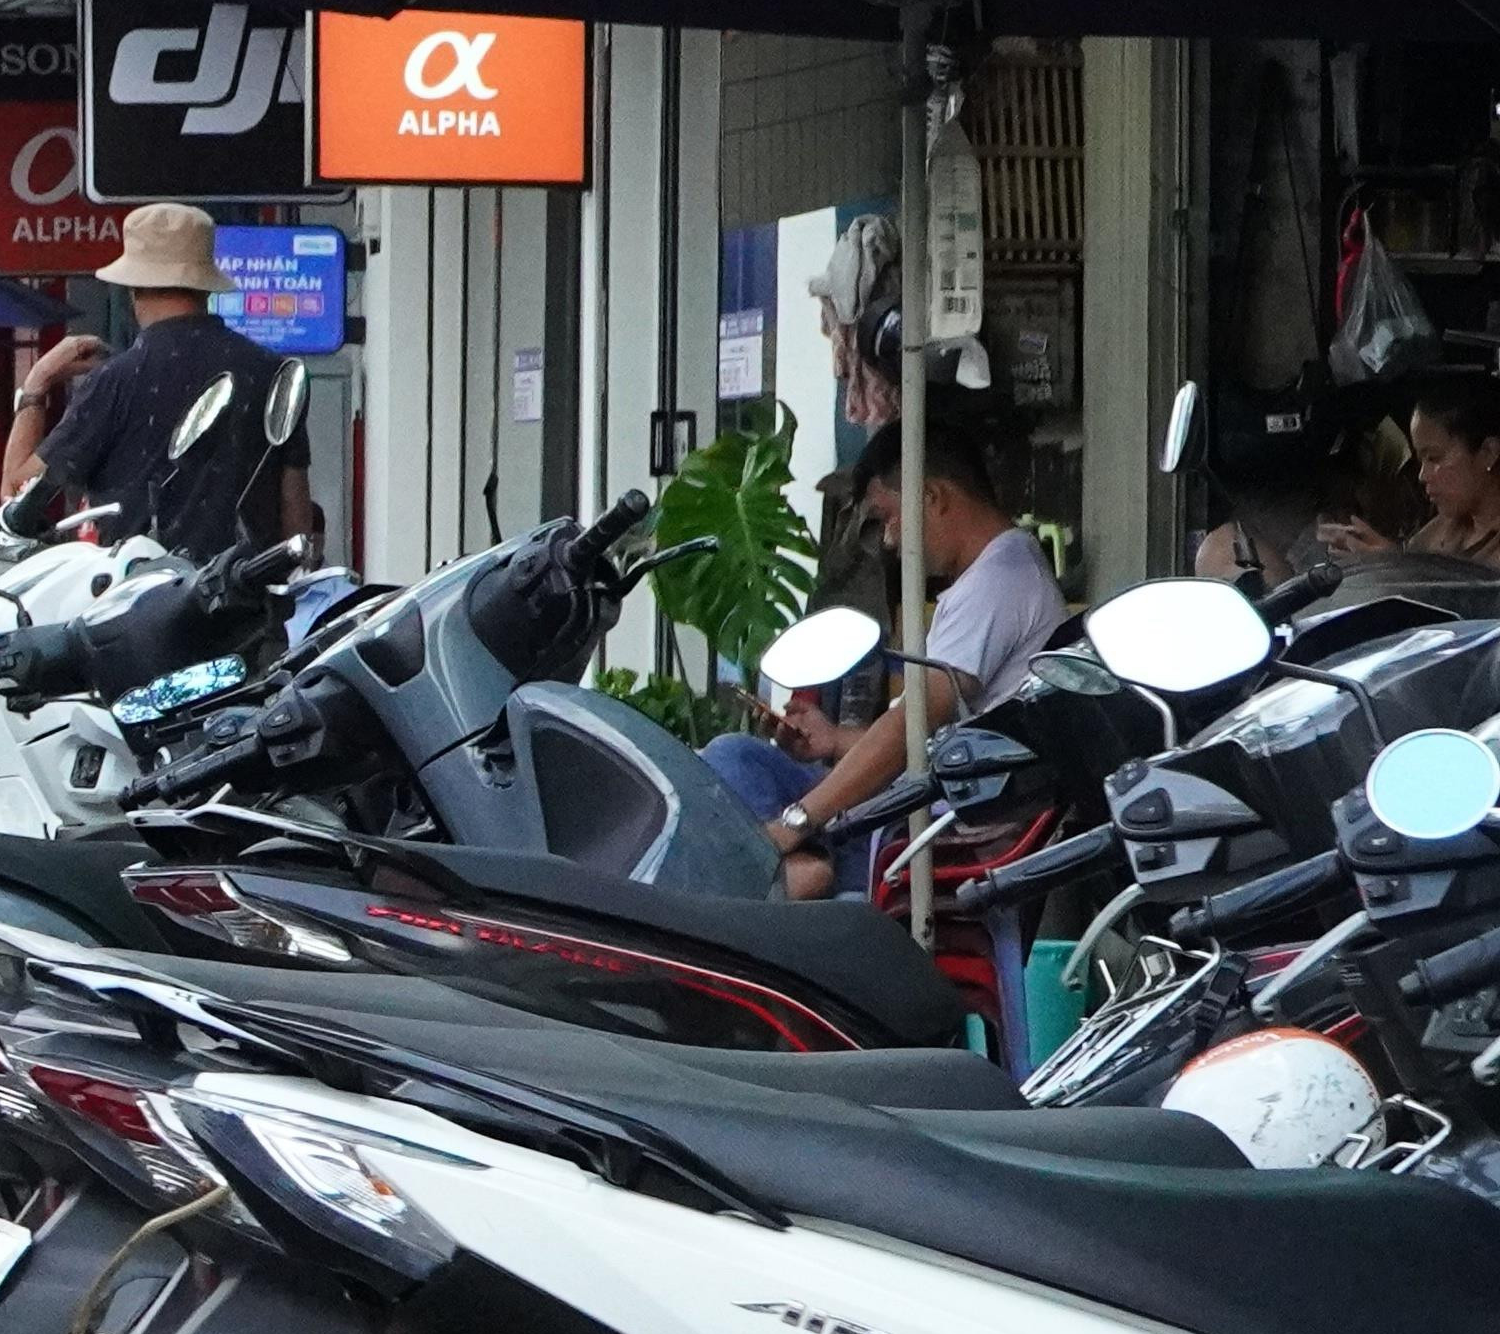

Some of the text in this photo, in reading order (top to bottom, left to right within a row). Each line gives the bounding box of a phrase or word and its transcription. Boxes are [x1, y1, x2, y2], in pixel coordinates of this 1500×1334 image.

[0, 43, 78, 75] SON
[398, 111, 501, 136] ALPHA
[12, 215, 120, 243] ALPHA
